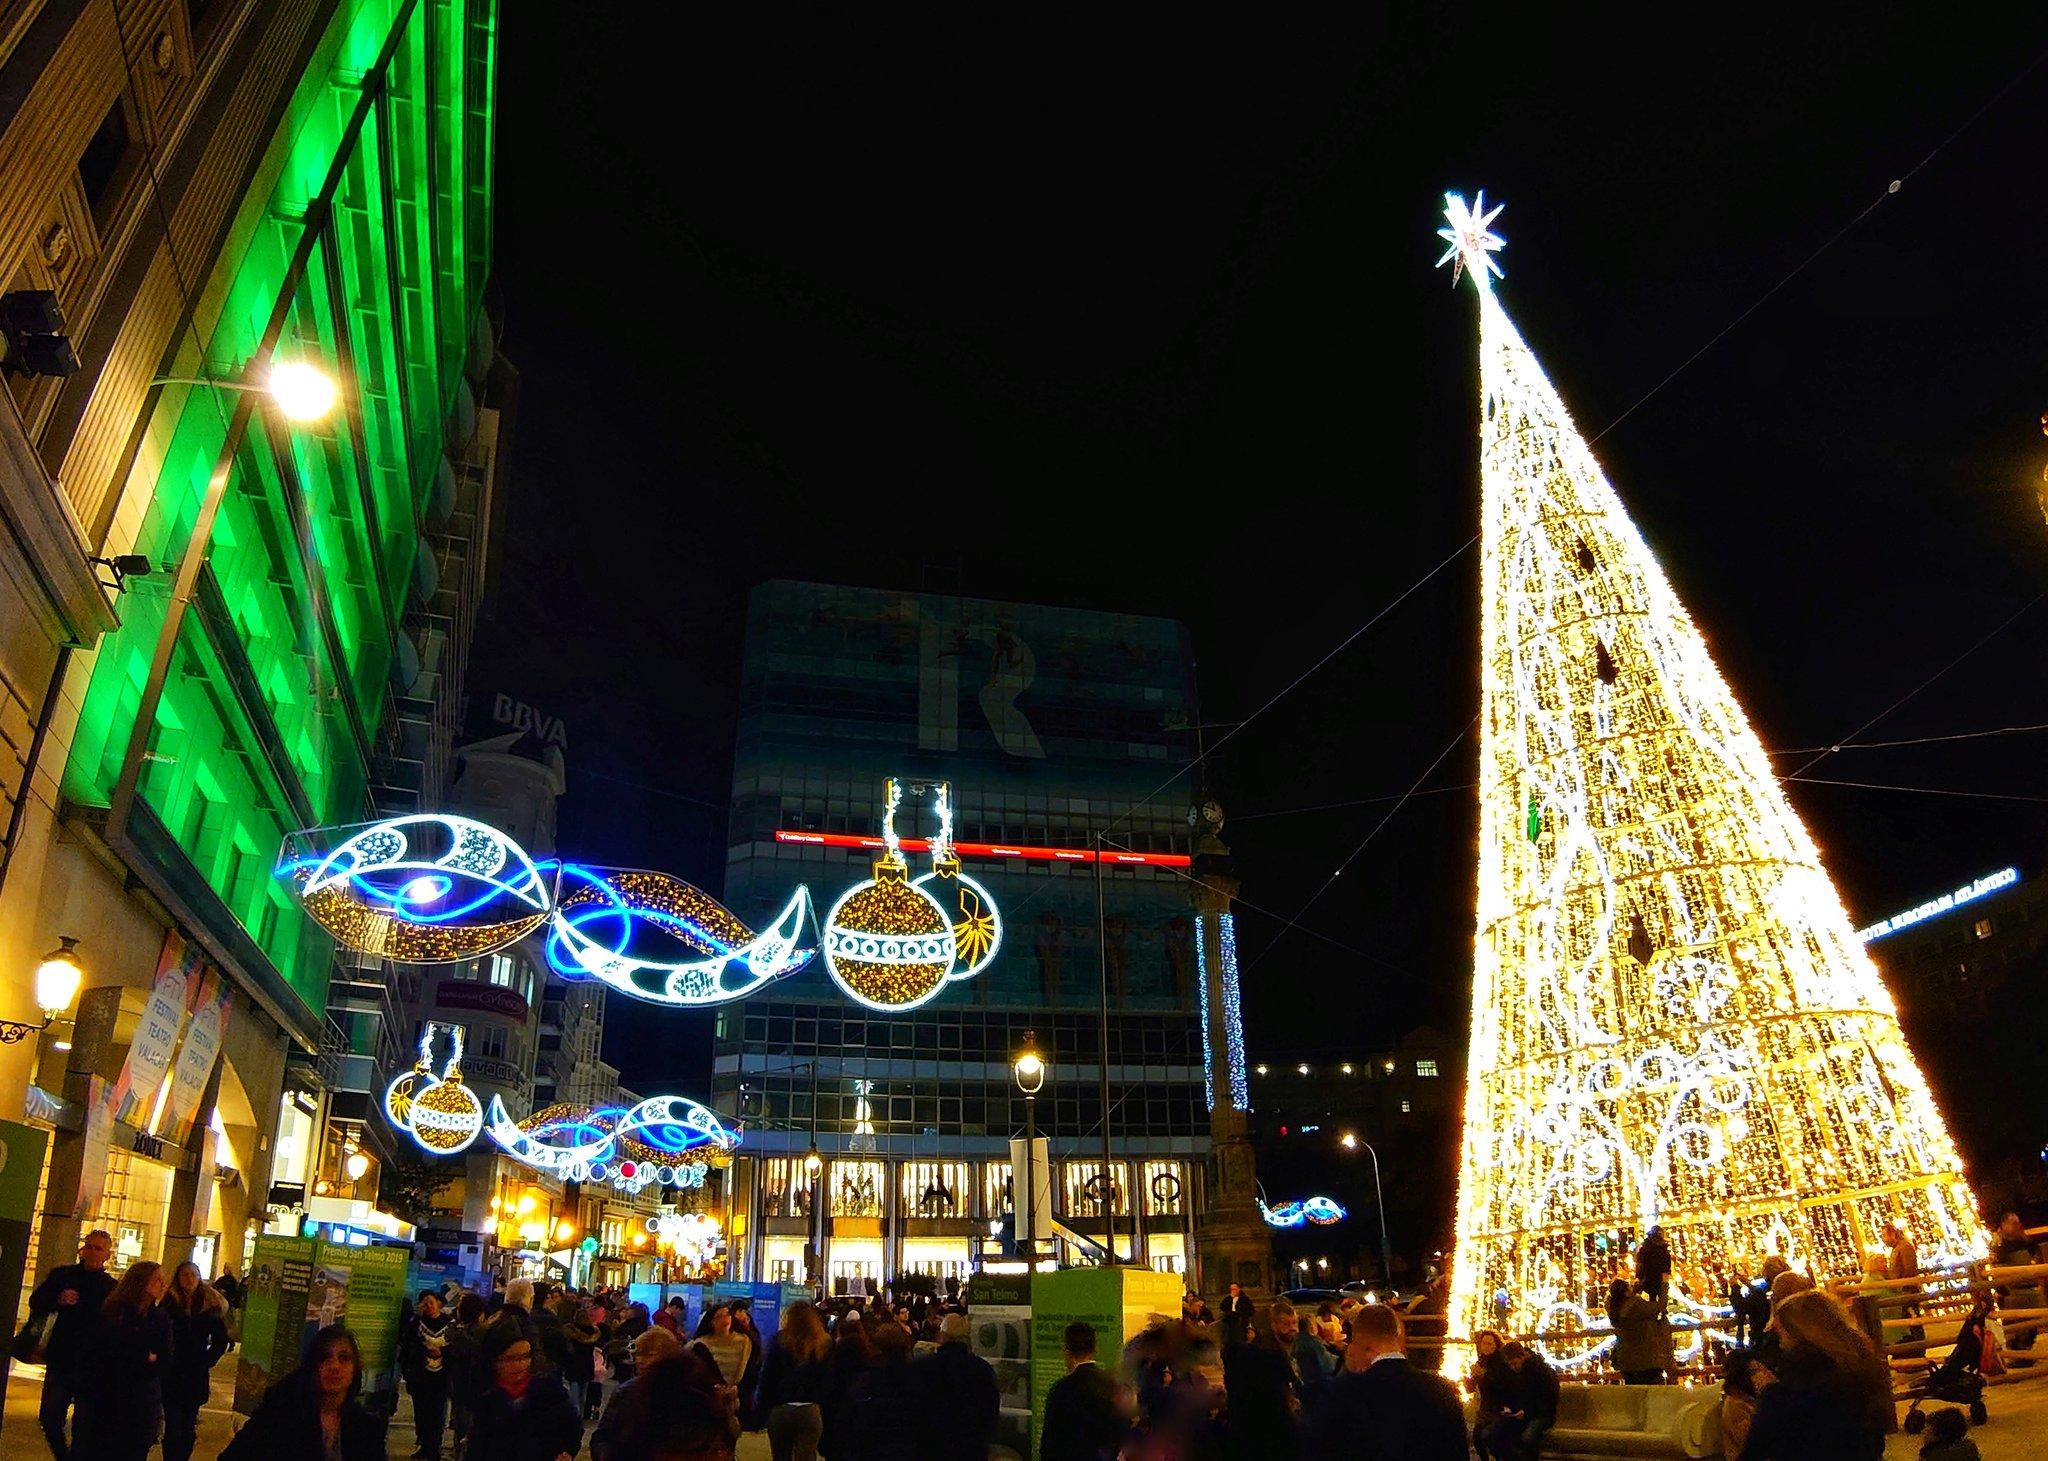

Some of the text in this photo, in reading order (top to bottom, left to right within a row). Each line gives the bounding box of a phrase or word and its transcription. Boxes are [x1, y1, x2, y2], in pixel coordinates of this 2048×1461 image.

[493, 692, 568, 750] BBVA
[152, 998, 178, 1028] FESTIVAL
[147, 1021, 172, 1048] TEATRO
[322, 1244, 349, 1259] Premio
[348, 1248, 363, 1260] San
[364, 1250, 386, 1262] Telmo
[386, 1252, 404, 1264] 2019
[973, 1286, 1019, 1301] San Telmo
